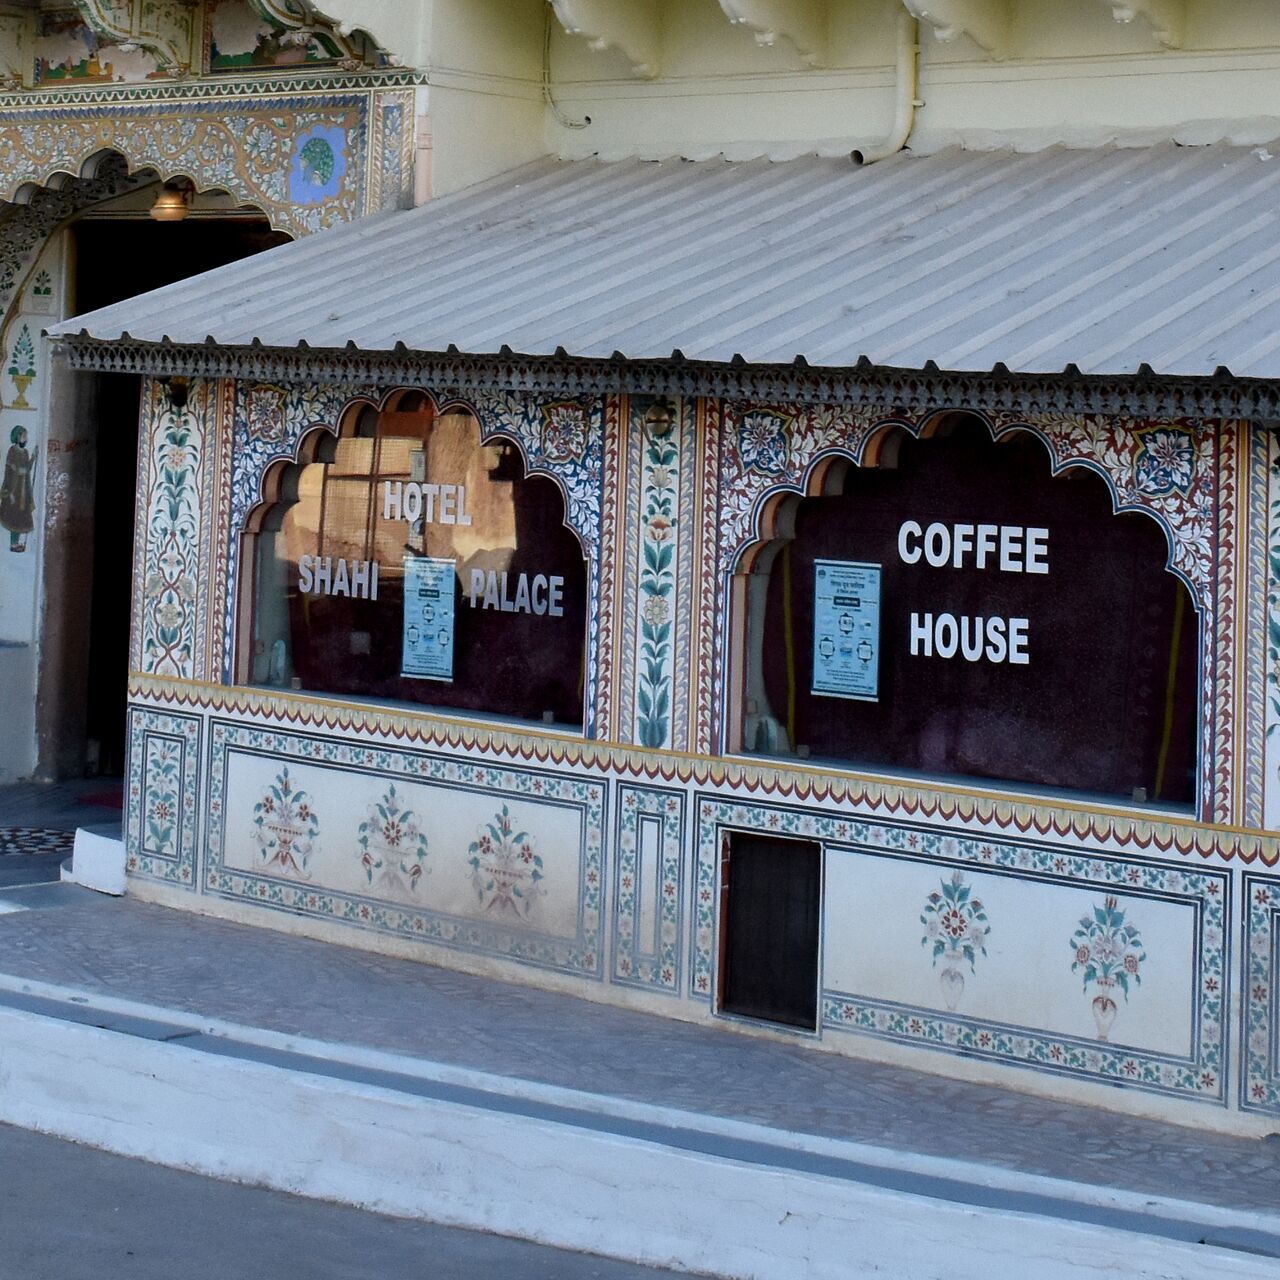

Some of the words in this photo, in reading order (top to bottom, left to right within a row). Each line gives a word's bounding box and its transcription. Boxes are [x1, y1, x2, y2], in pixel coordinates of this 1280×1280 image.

[383, 480, 472, 526] HOTEL
[898, 520, 1049, 574] COFFEE
[298, 554, 379, 601] SHAHI
[469, 568, 565, 617] PALACE
[910, 612, 1030, 664] HOUSE
